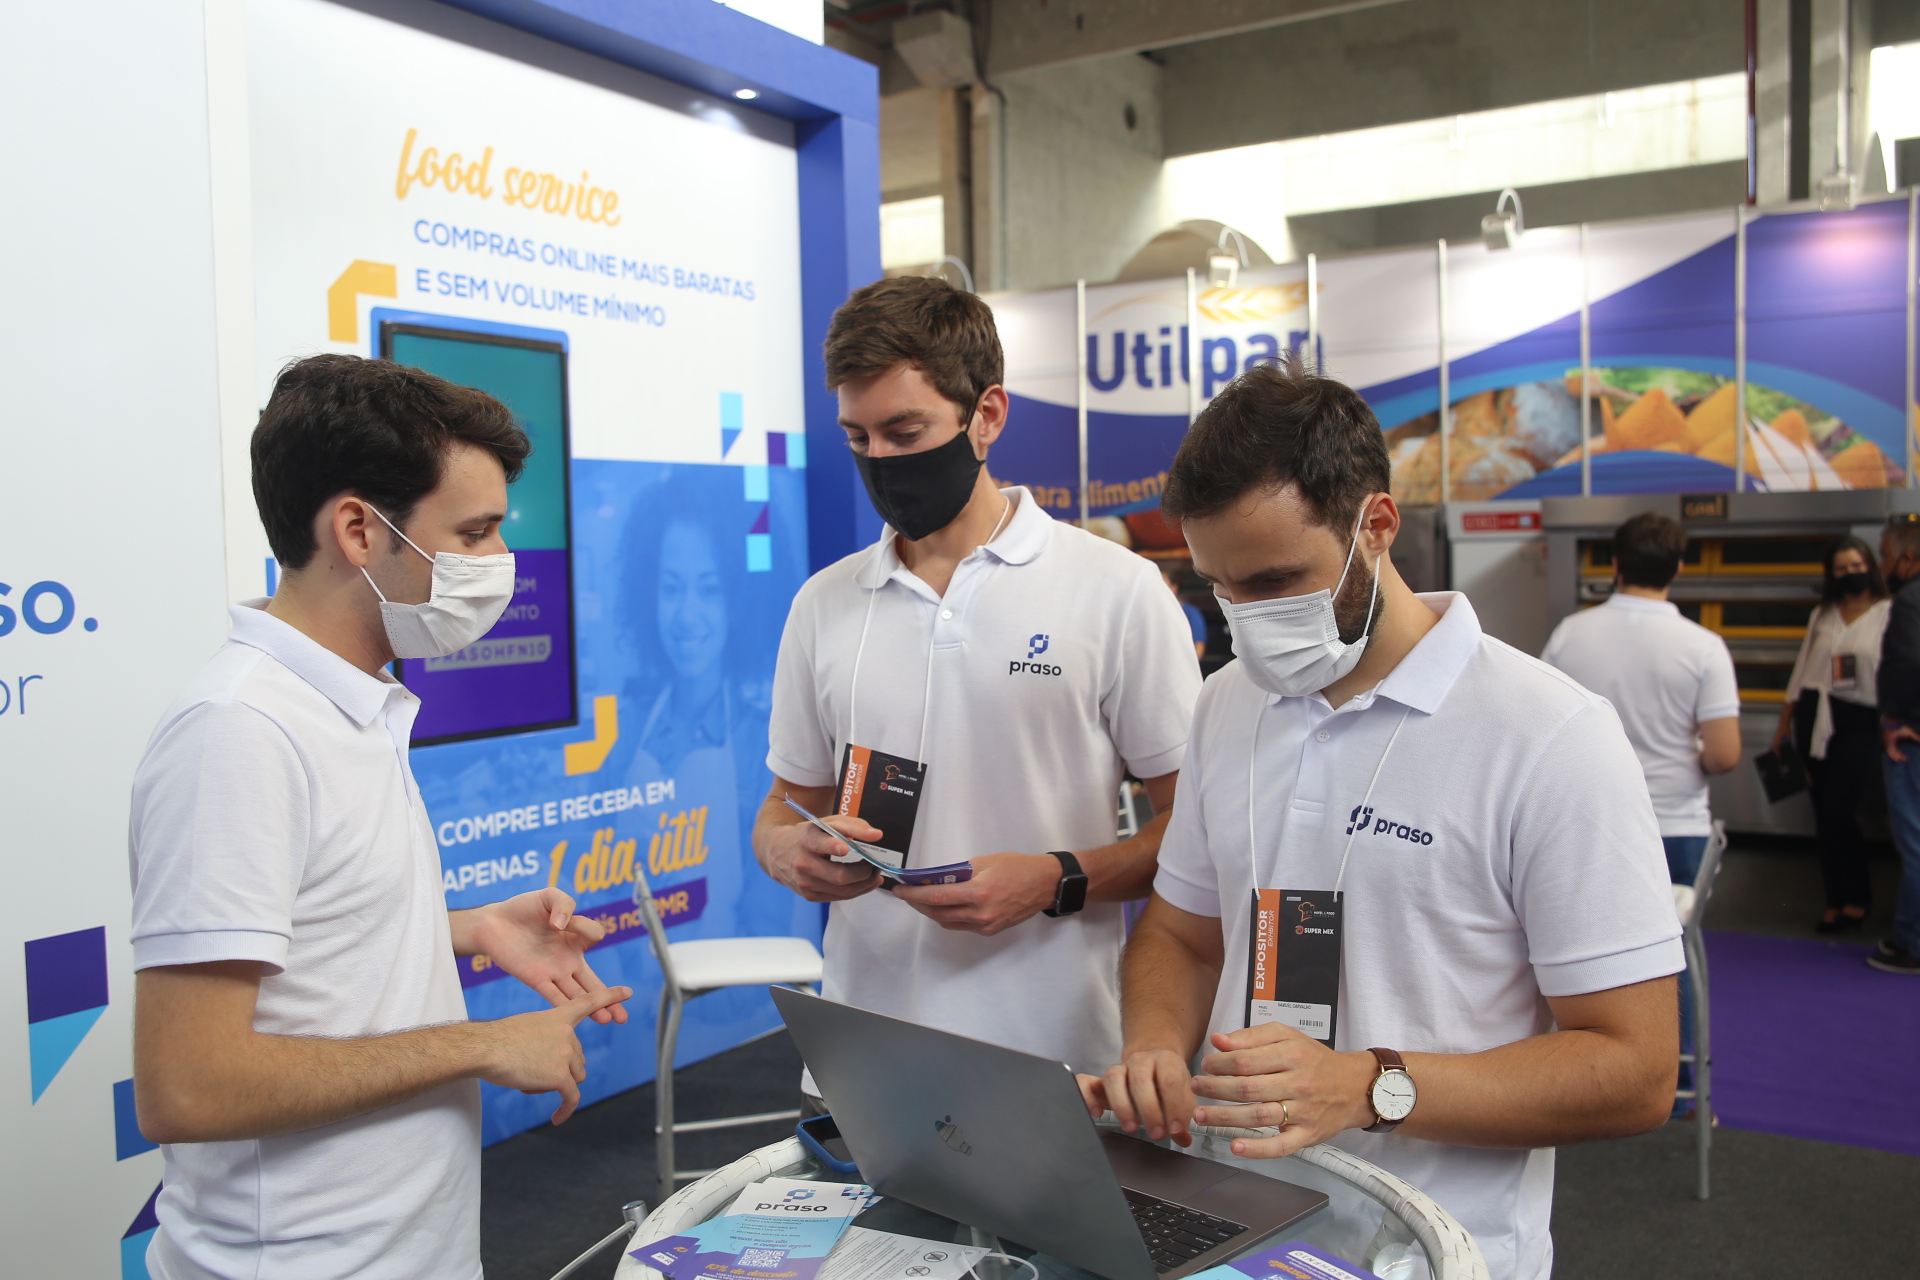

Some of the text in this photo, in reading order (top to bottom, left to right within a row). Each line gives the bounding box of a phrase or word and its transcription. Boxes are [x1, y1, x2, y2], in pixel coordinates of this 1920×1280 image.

[396, 128, 622, 228] food service
[414, 219, 756, 302] COMPRAS ONLINE MAIS BARATAS
[416, 269, 666, 327] E SEM VOLUME MÍNIMO
[1009, 660, 1062, 676] praso
[438, 778, 676, 847] COMPRE E RECEBA EM
[839, 762, 859, 817] XPOSITOR
[887, 785, 915, 797] SUPER MIX
[443, 805, 710, 894] APENAS 1 dia útil
[1373, 818, 1434, 846] praso
[1255, 909, 1269, 990] EXPOSITOR
[1267, 909, 1275, 948] EXHIBITOR
[1304, 927, 1322, 935] SUPER
[754, 1202, 828, 1213] praso
[705, 1263, 729, 1272] 10%
[746, 1270, 799, 1279] desconto
